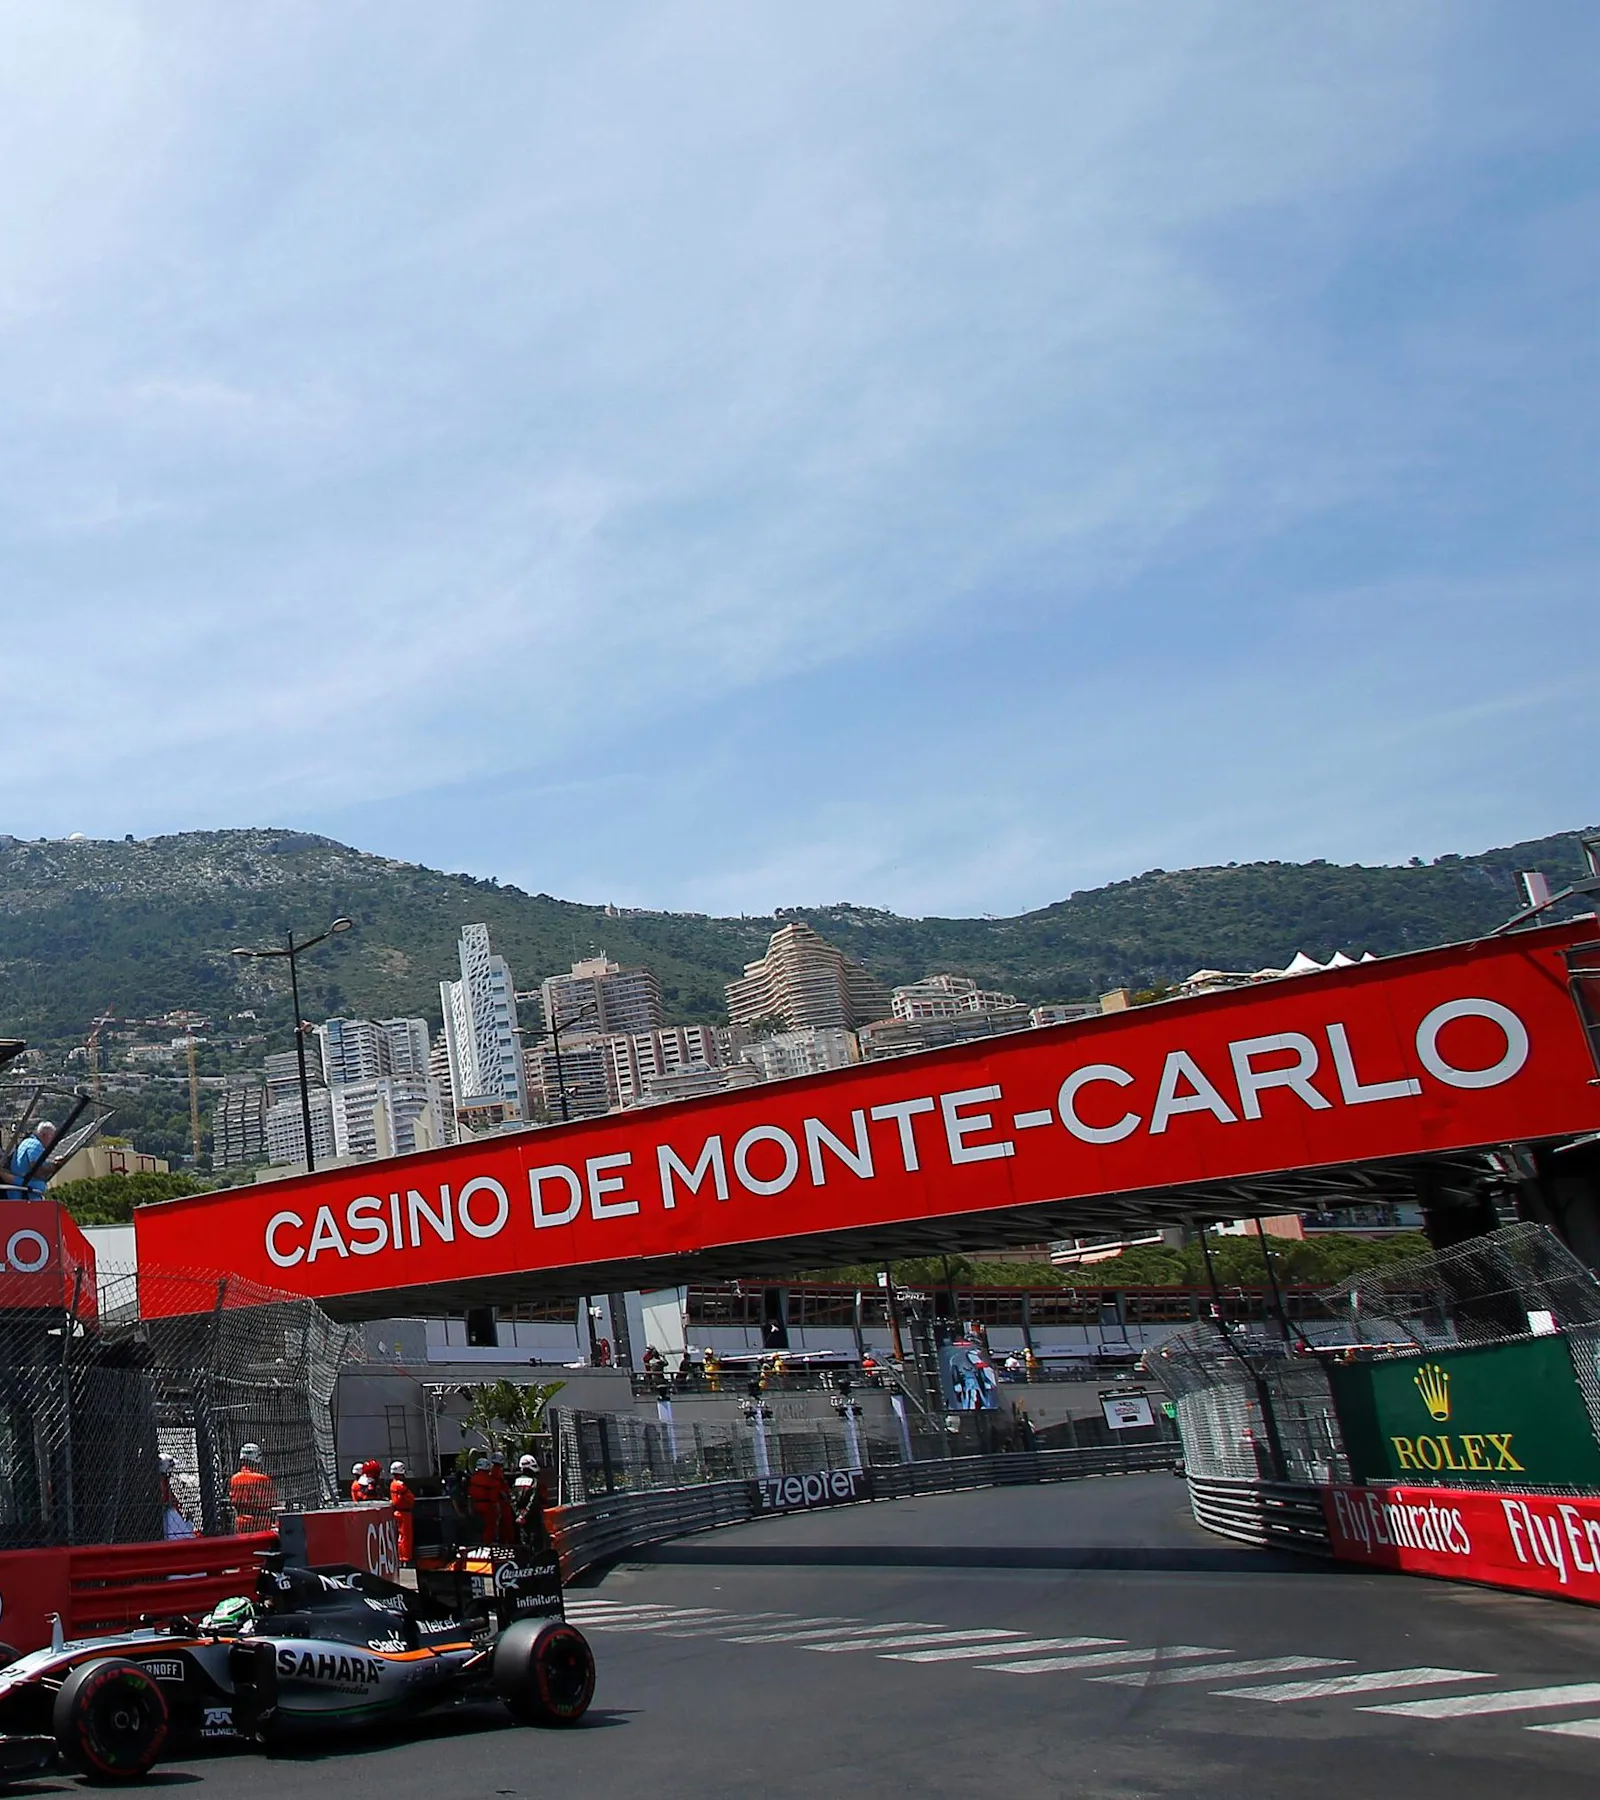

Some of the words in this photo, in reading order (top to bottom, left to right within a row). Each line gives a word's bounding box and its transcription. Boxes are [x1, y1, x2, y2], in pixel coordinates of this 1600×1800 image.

[265, 1176, 510, 1268] CASINO
[528, 1151, 641, 1230] DE
[657, 998, 1530, 1211] MONTE-CARLO
[1390, 1434, 1525, 1471] ROLEX
[1333, 1491, 1372, 1553] Fly
[1368, 1491, 1471, 1555] Emirates
[1500, 1499, 1567, 1584] Fly
[318, 1572, 363, 1591] NEC
[277, 1649, 381, 1684] SAHARA
